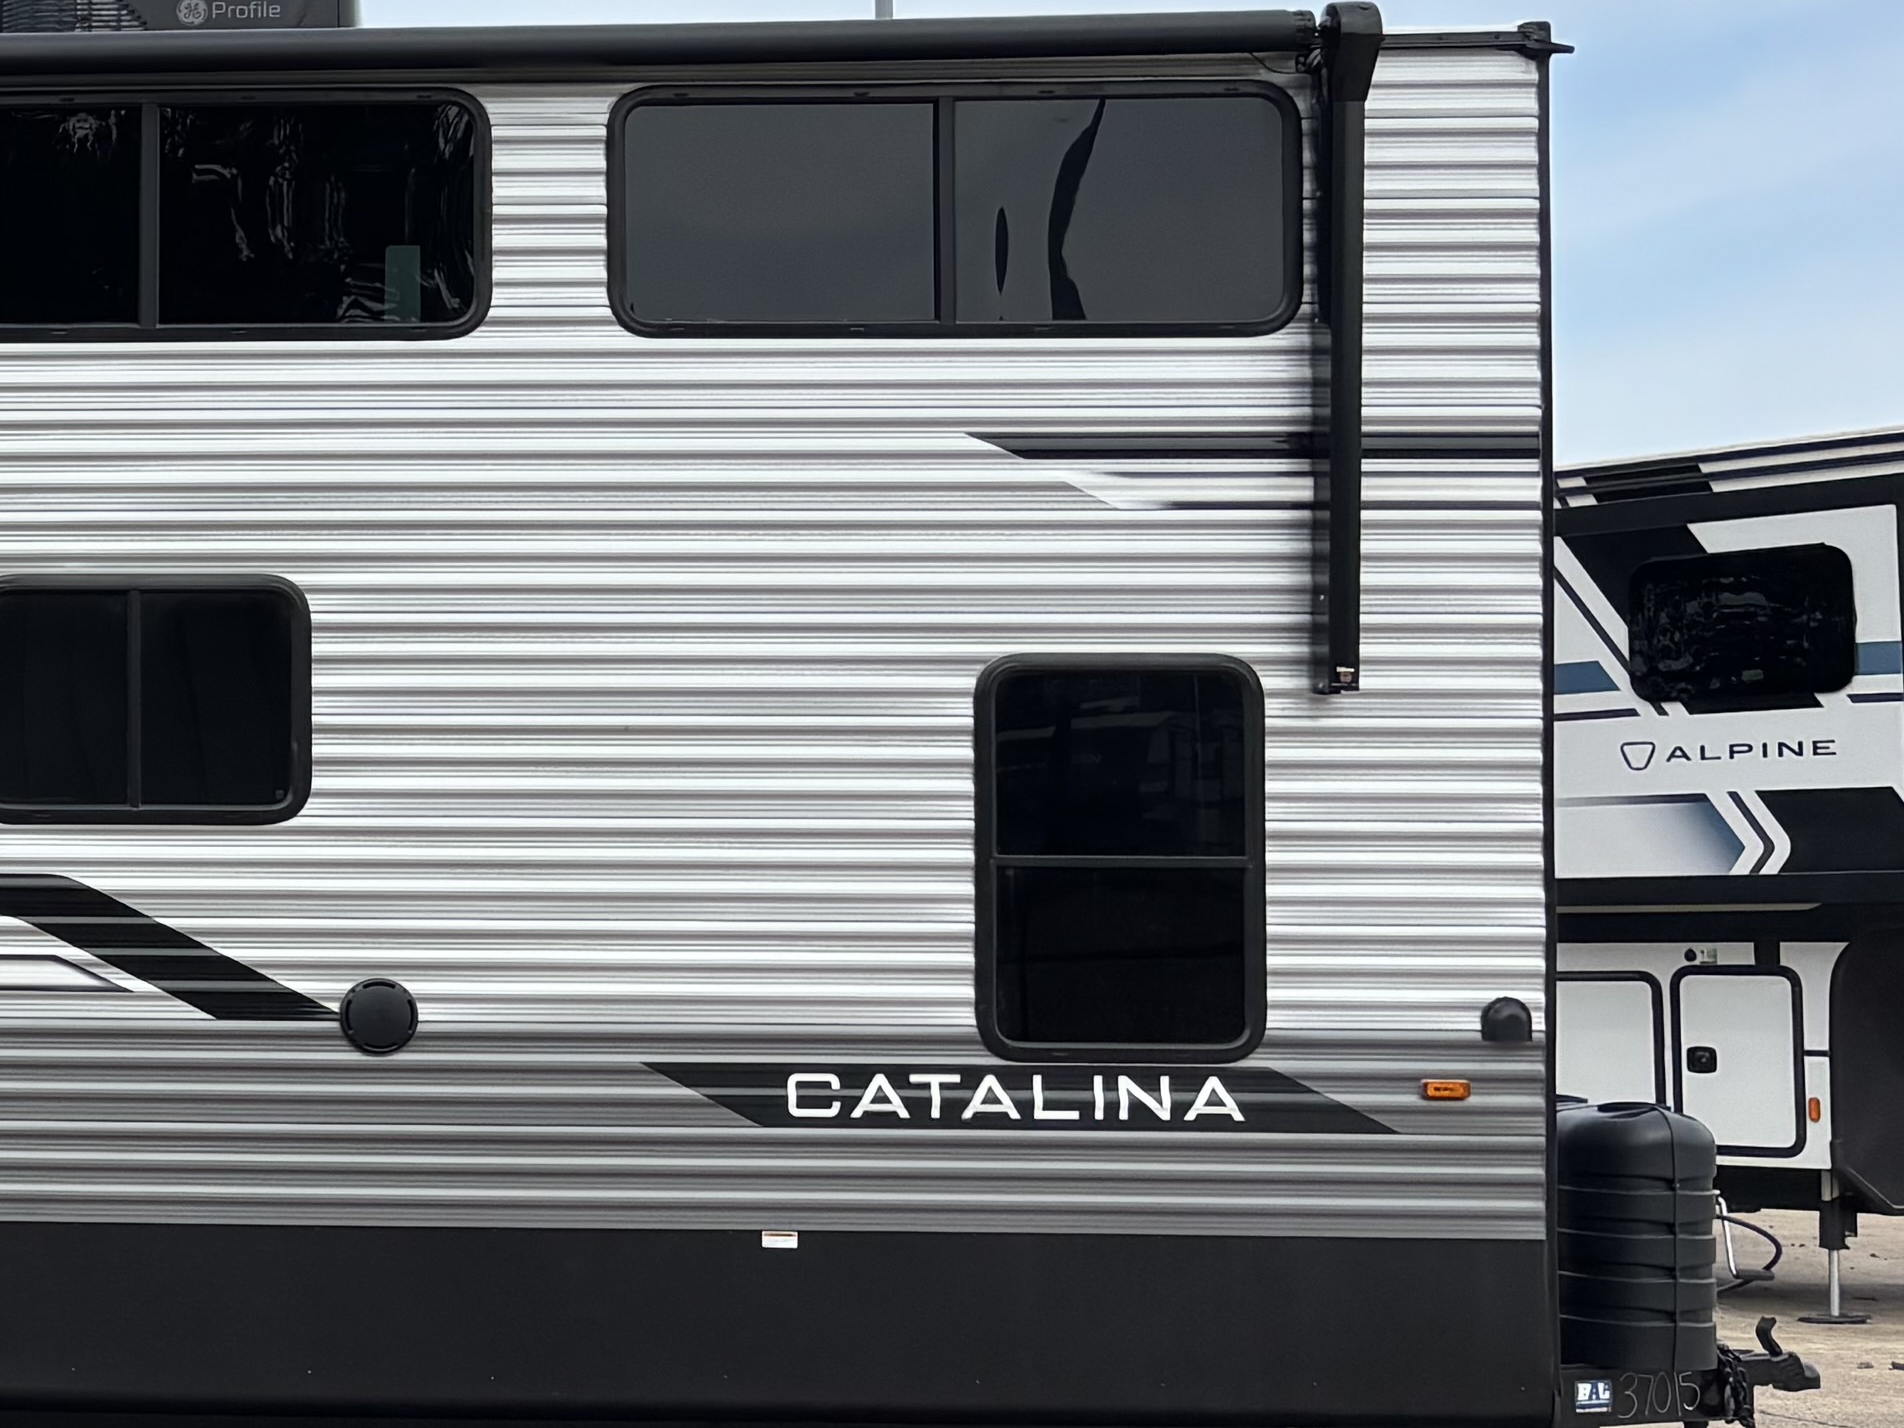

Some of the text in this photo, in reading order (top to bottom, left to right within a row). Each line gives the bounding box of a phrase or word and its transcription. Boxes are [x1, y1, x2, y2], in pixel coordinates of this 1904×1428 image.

[212, 0, 281, 19] Profile
[1665, 739, 1837, 763] ALPINE
[786, 1073, 1246, 1122] CATALINA
[1618, 1371, 1701, 1418] 37015
